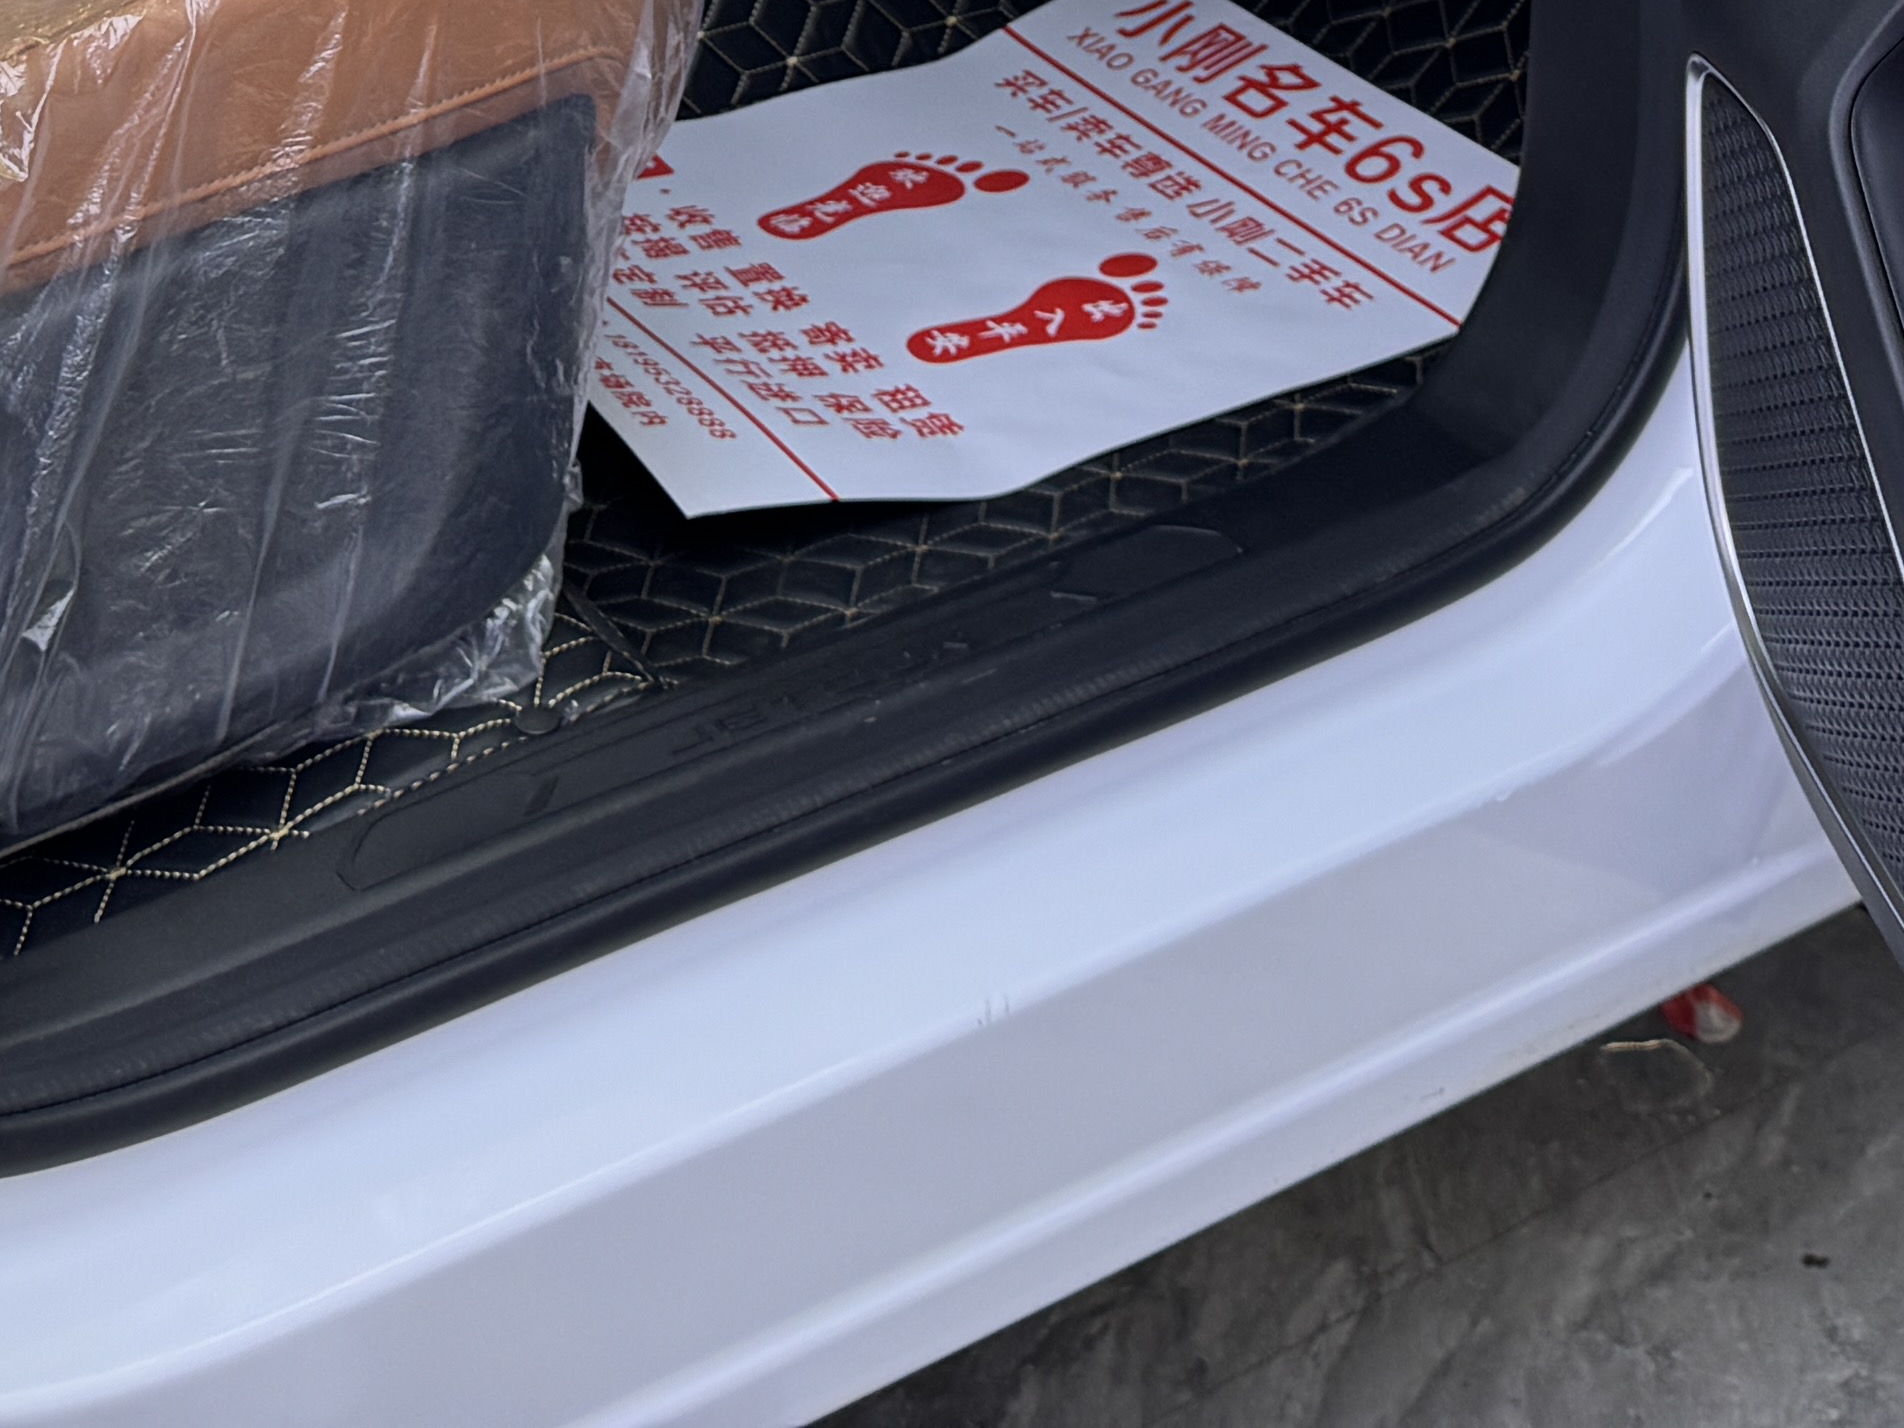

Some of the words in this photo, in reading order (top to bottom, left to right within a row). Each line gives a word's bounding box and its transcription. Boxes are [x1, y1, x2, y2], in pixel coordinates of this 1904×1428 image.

[1067, 26, 1134, 72] XIAO
[1130, 67, 1209, 119] GANG
[1201, 112, 1278, 163] MING
[1273, 158, 1340, 204] CHE
[1333, 196, 1380, 228] 6S
[1373, 222, 1457, 275] DIAN
[924, 299, 1129, 358] 出入平安
